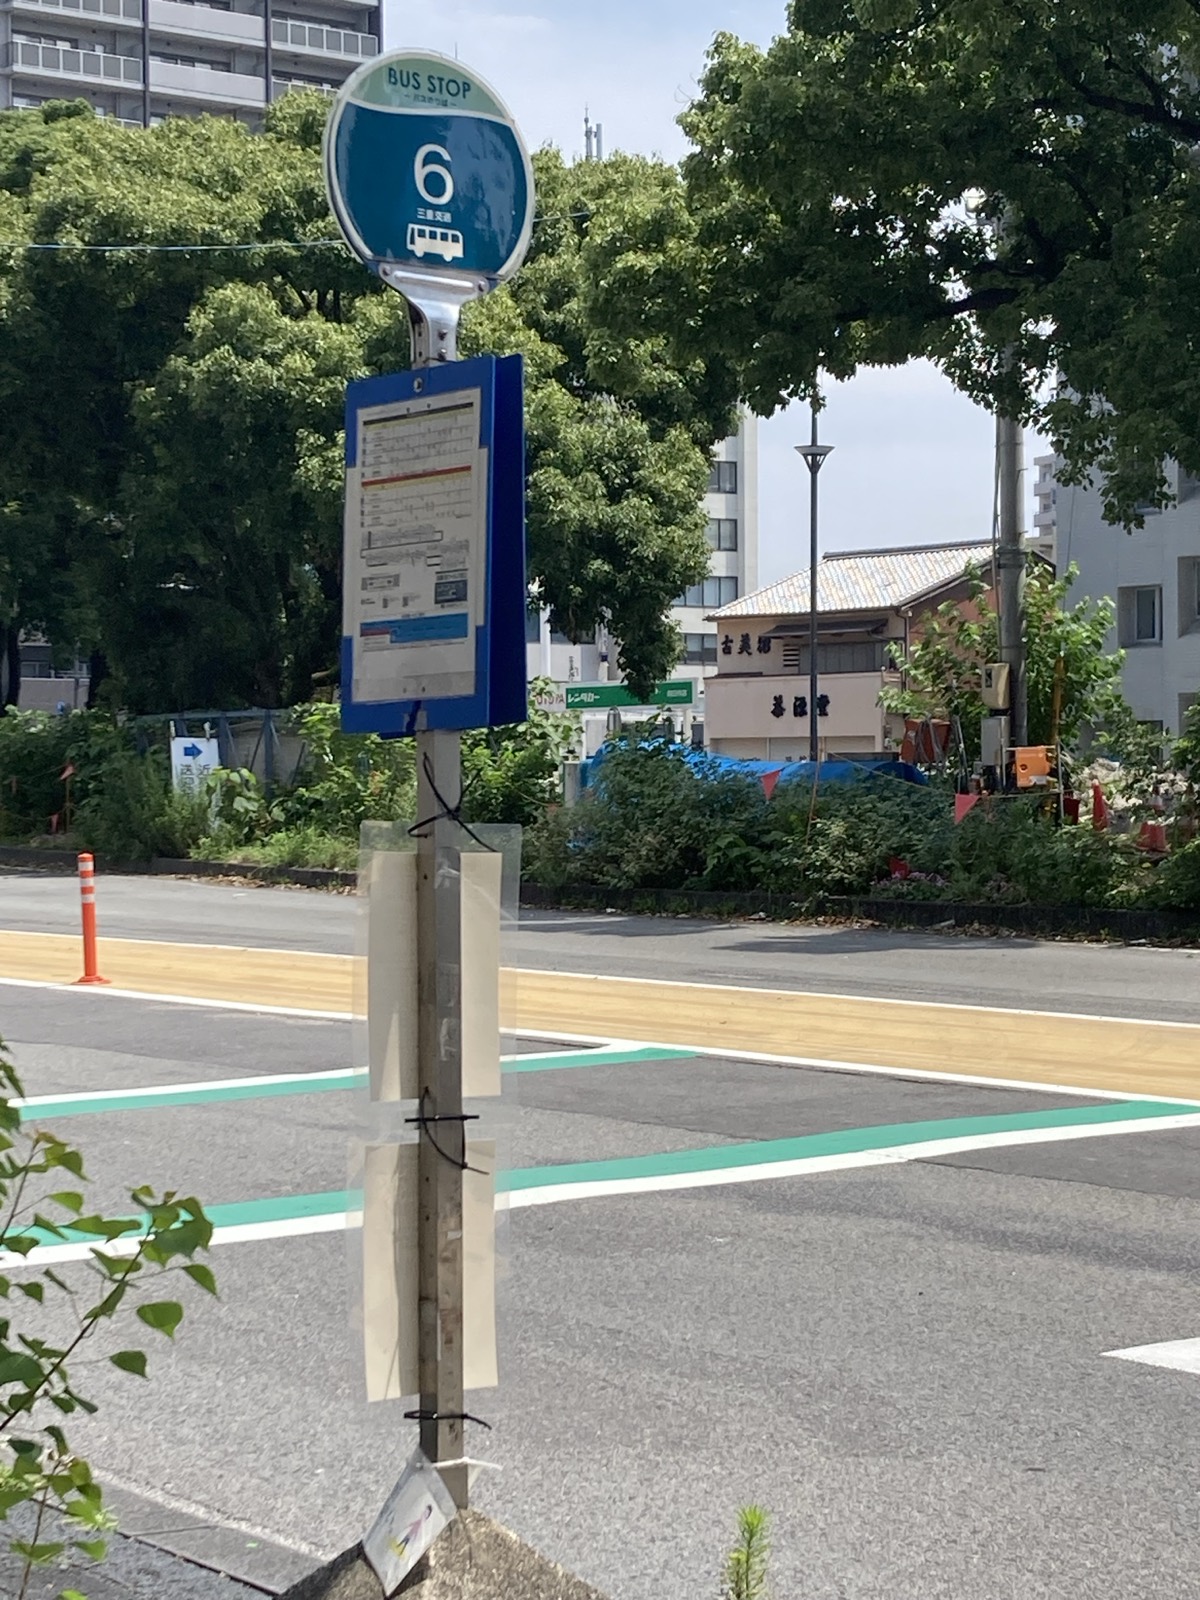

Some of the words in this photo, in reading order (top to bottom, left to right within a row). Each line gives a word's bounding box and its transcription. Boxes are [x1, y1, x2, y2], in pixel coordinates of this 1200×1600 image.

[388, 67, 421, 90] BUS
[427, 74, 471, 99] STOP
[414, 143, 454, 205] 6
[567, 691, 600, 703] レンタカー
